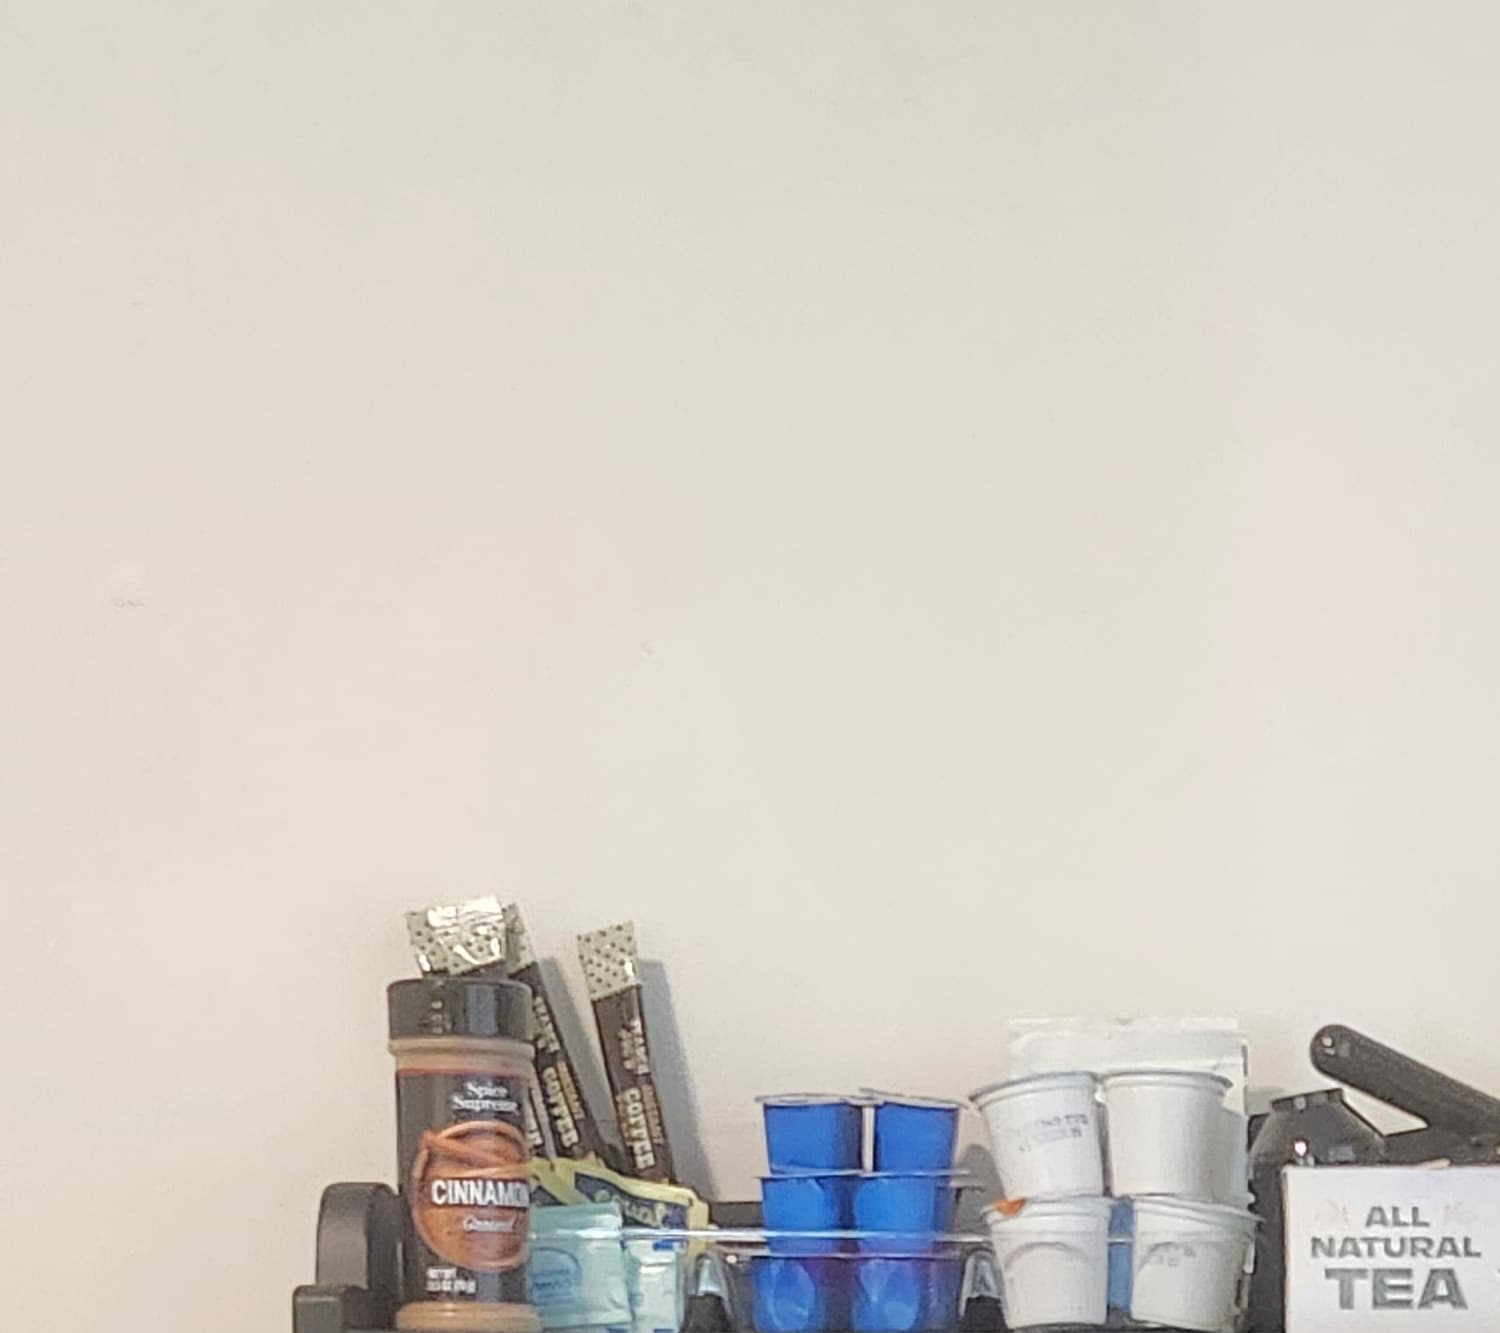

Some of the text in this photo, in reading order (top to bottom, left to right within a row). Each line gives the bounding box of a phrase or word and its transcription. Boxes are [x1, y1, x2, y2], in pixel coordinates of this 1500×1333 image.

[622, 1087, 656, 1170] COFFEE
[1366, 1205, 1431, 1228] ALL
[1310, 1236, 1483, 1259] NATURAL
[1324, 1267, 1469, 1310] TEA
